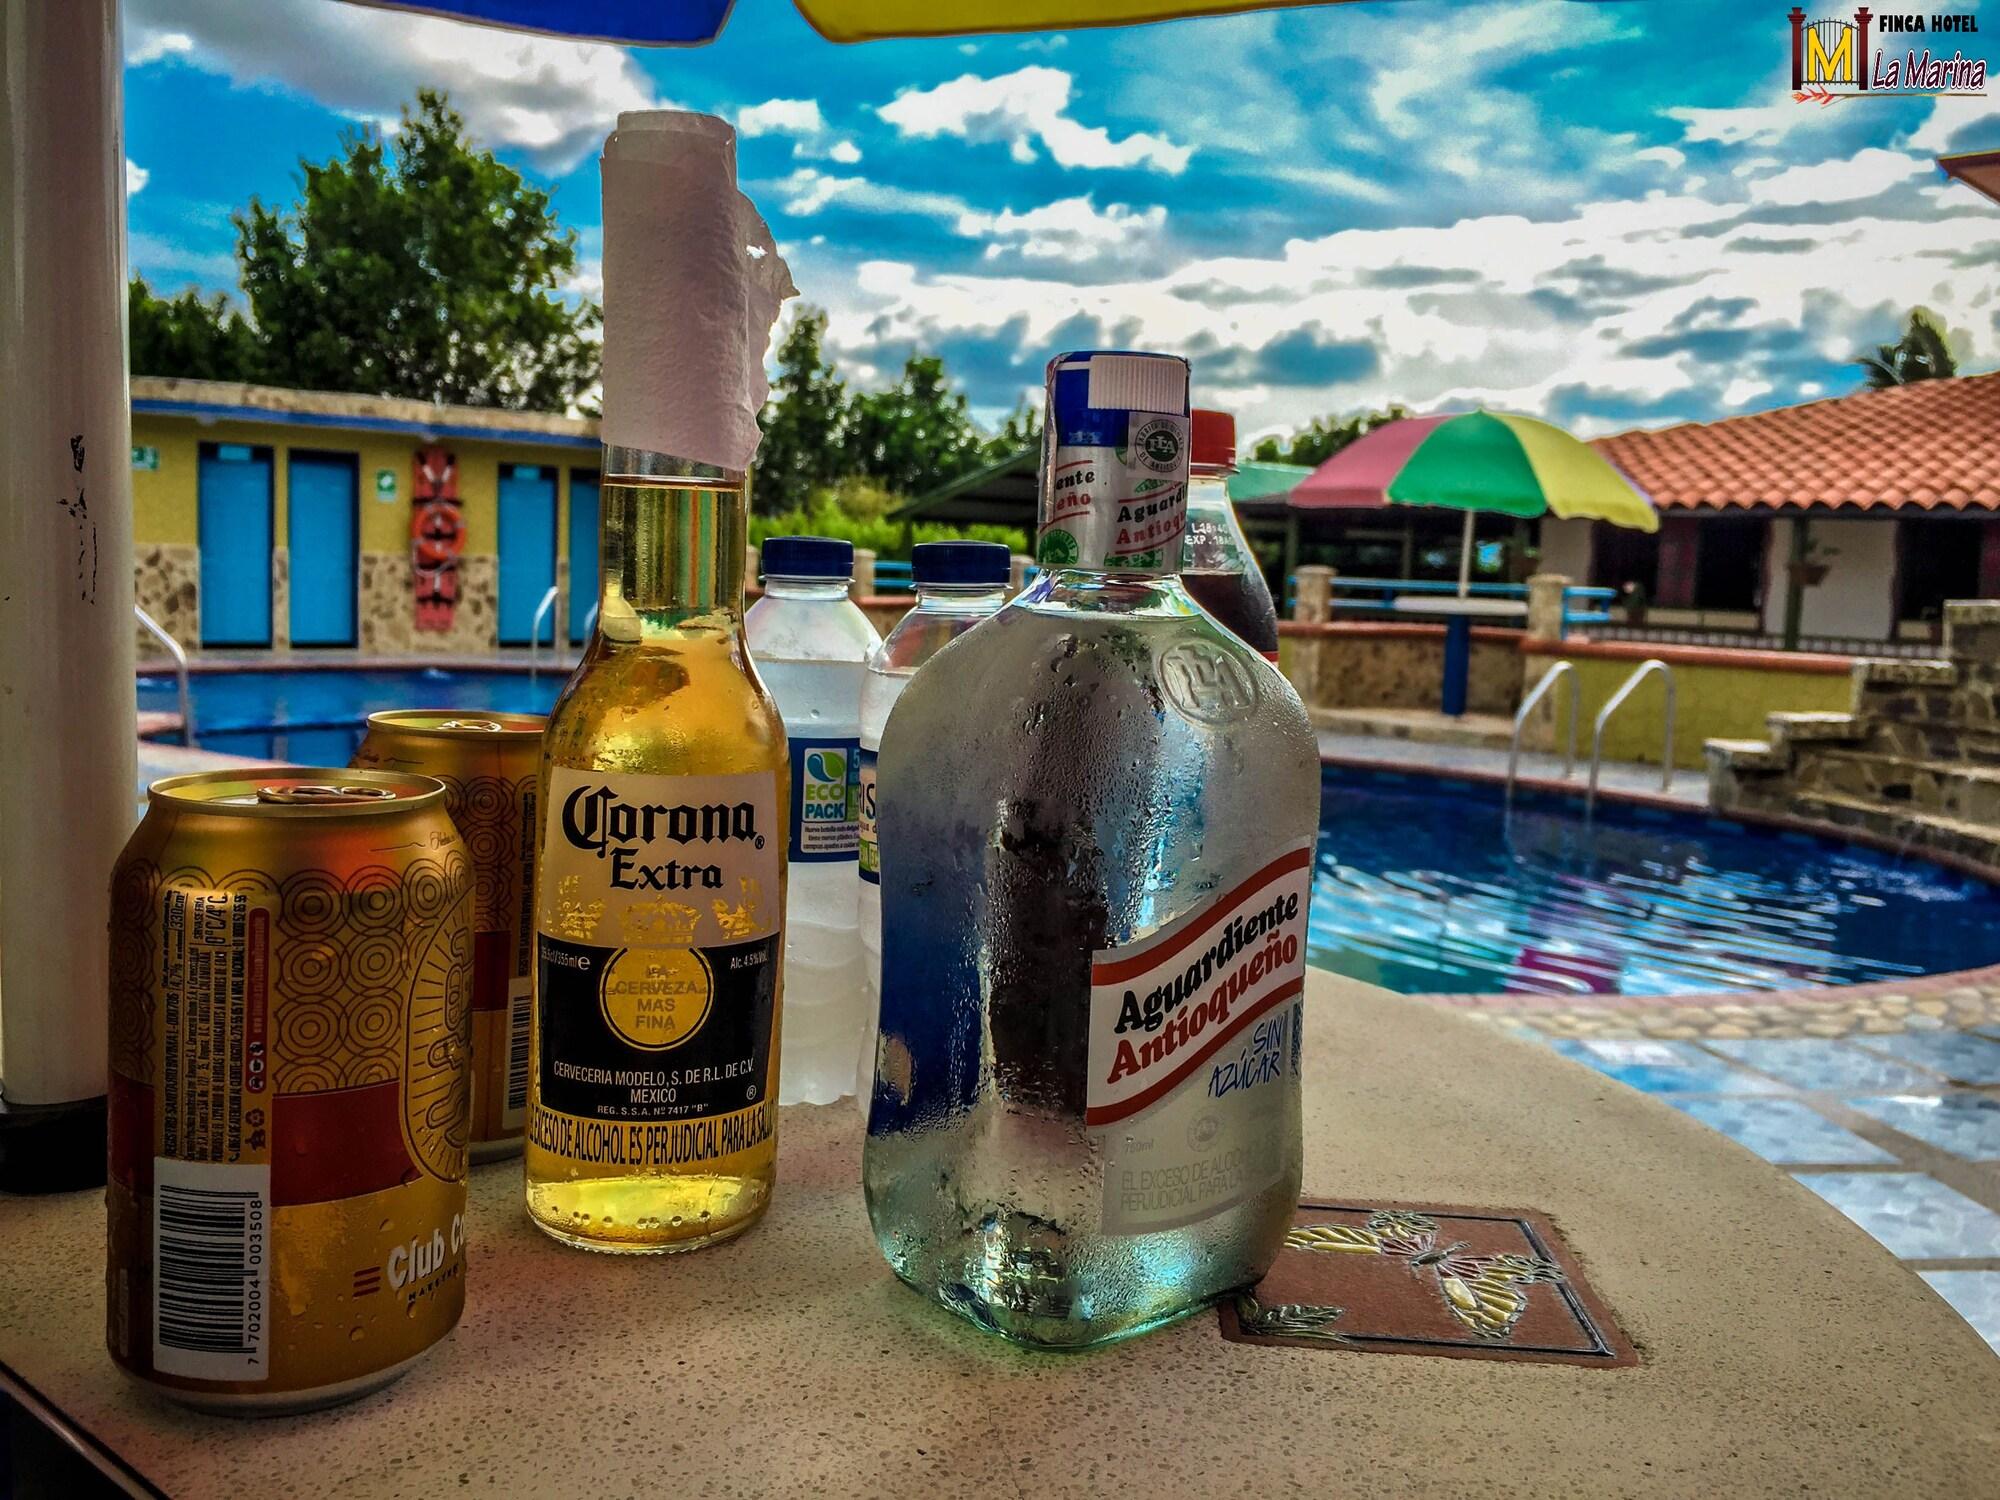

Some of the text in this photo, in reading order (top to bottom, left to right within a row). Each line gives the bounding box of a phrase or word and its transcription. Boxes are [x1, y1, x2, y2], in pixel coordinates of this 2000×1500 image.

[805, 783, 845, 801] ECO
[562, 784, 758, 859] Corona
[804, 802, 845, 819] PACK
[609, 846, 724, 891] Extra
[1113, 891, 1299, 1034] Aguardiente
[615, 980, 698, 996] CERVEZA
[637, 998, 676, 1012] MAS
[635, 1015, 676, 1030] FINA
[1106, 929, 1298, 1085] Antioqueño
[1253, 1010, 1284, 1051] SIN
[553, 1059, 613, 1087] CERVECERIA
[685, 1069, 701, 1083] DE
[725, 1062, 738, 1078] DE
[1207, 1047, 1281, 1098] AZÚCAR
[597, 1104, 619, 1115] REG.
[667, 1104, 689, 1115] 7417
[630, 1087, 677, 1104] MEXICO
[560, 1116, 573, 1158] DE
[574, 1119, 626, 1165] ALCOHOL
[629, 1125, 643, 1166] ES
[645, 1118, 719, 1166] PERJUDICIAL
[721, 1113, 745, 1157] PARA
[1121, 1170, 1137, 1191] EL
[1140, 1165, 1190, 1190] EXCESO
[1191, 1159, 1209, 1182] DE
[1120, 1180, 1197, 1212] PERJUDICIAL
[248, 1199, 263, 1266] 003508
[386, 1228, 447, 1291] Club
[247, 1278, 262, 1342] 702004
